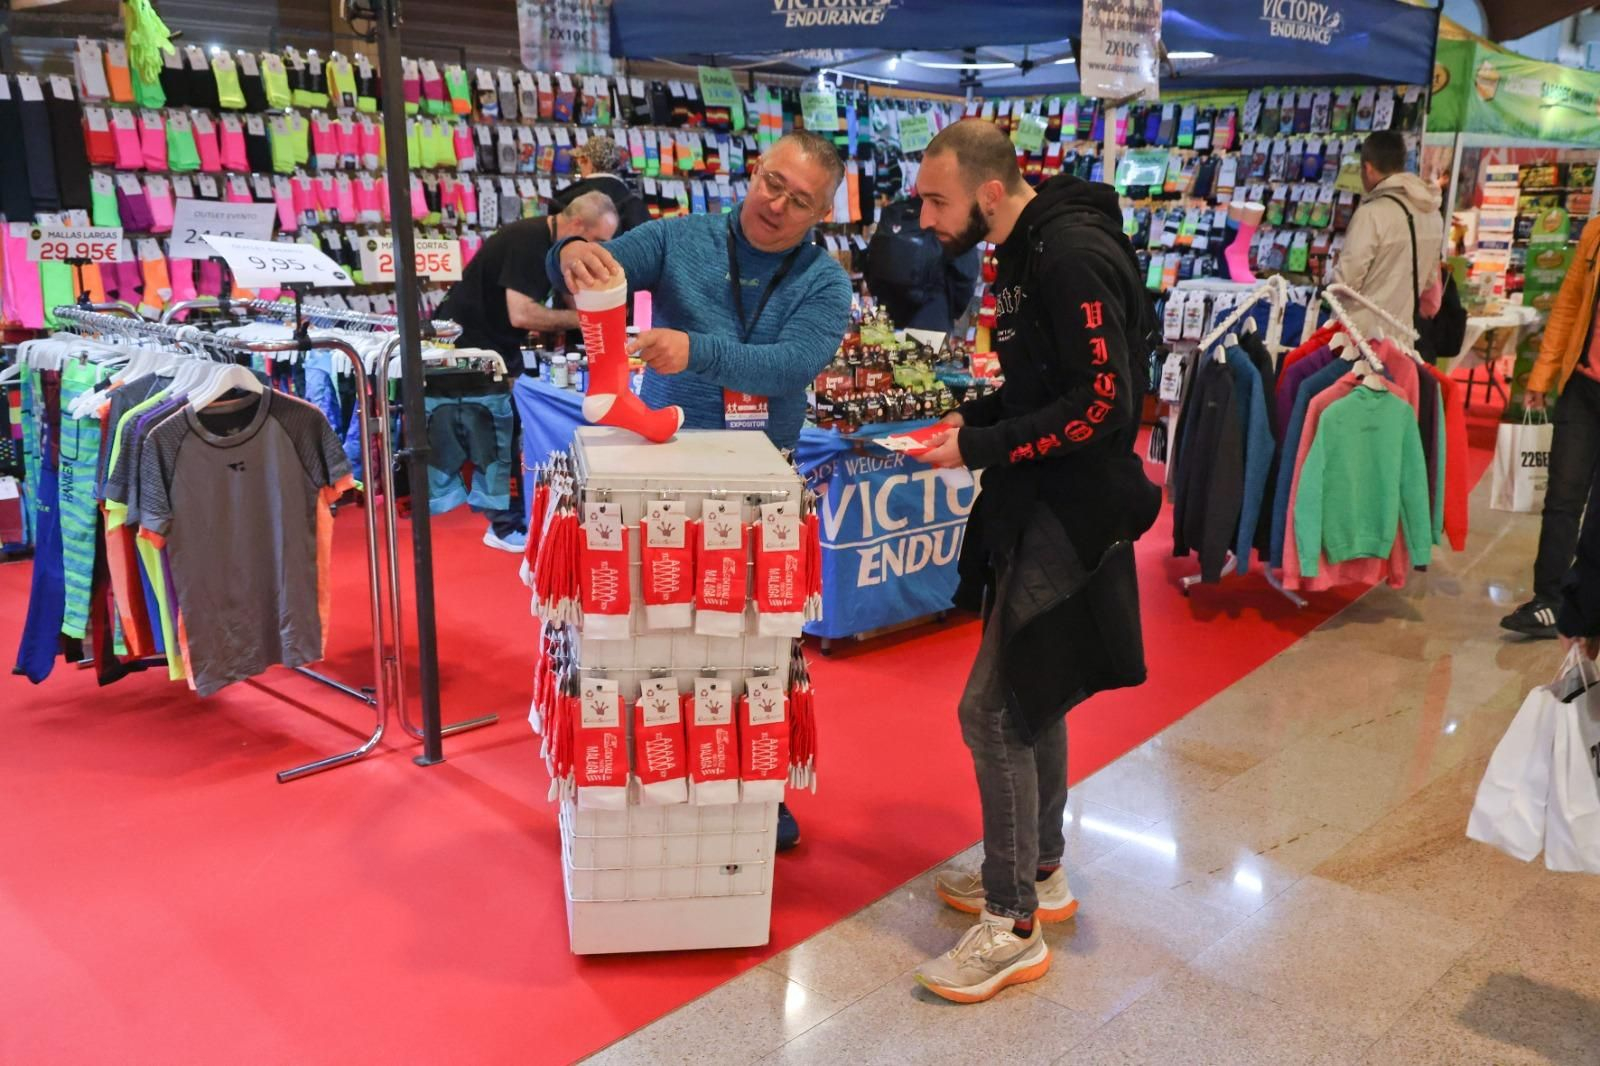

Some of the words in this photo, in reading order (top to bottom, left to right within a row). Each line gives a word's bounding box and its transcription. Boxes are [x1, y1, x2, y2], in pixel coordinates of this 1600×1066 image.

[785, 9, 881, 28] ENDURANCE
[1262, 0, 1329, 26] VICTORY
[1270, 21, 1332, 45] ENDURANCE
[194, 210, 225, 220] OUTLET
[226, 212, 258, 221] EVENTO
[47, 231, 82, 240] MALLAS
[83, 231, 118, 240] LARGAS
[40, 242, 118, 261] 2995€
[416, 242, 449, 250] CORTAS
[248, 256, 306, 272] 9,95
[1521, 450, 1552, 468] 226E
[857, 525, 968, 588] ENDU
